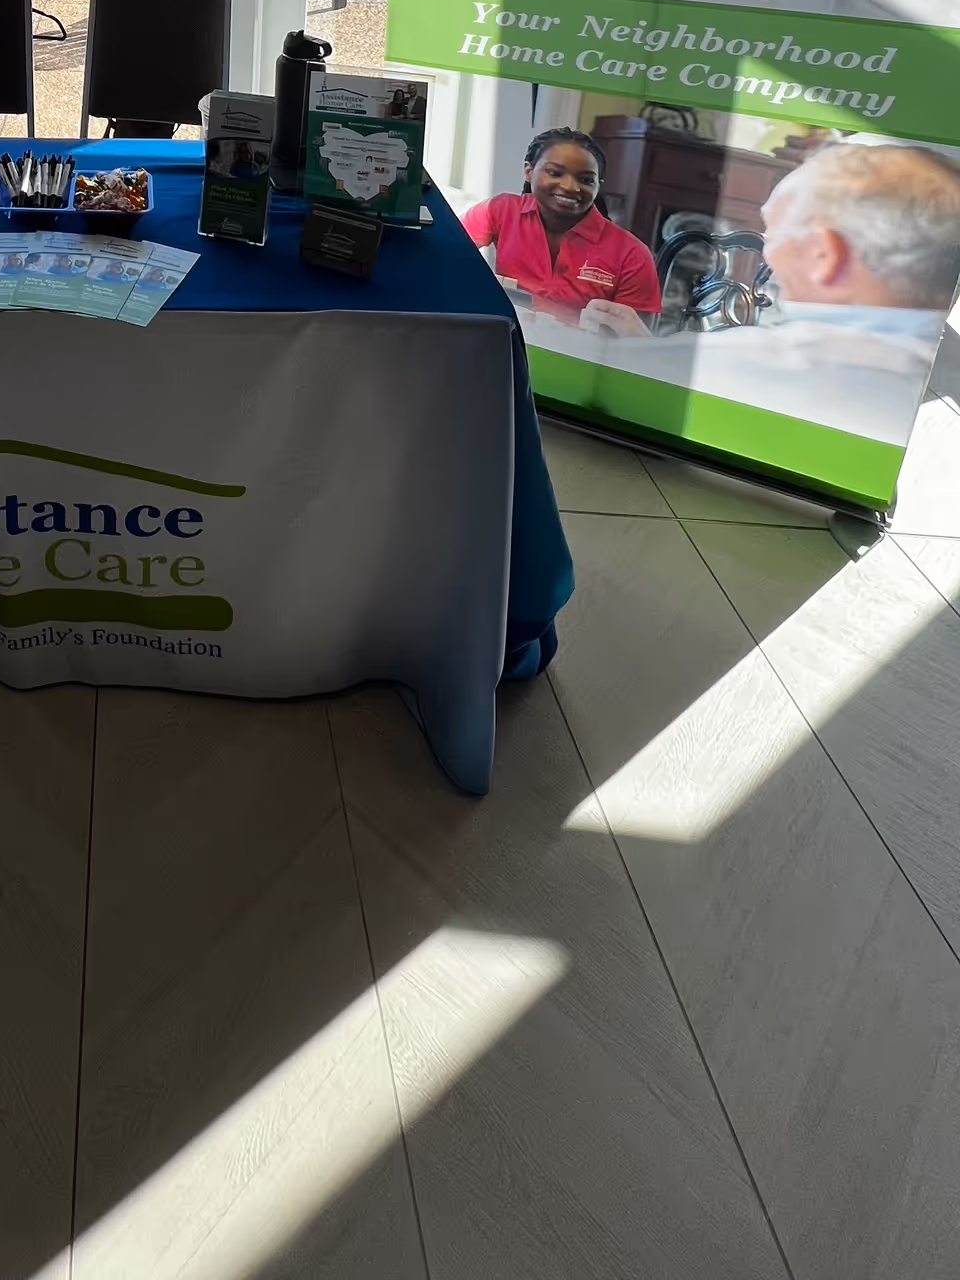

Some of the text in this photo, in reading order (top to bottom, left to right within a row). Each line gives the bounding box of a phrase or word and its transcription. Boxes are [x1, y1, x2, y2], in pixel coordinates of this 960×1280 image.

[472, 1, 899, 75] Your Neighborhood
[457, 33, 897, 118] Home Care Company
[45, 538, 206, 588] Care
[91, 628, 223, 658] Foundation
